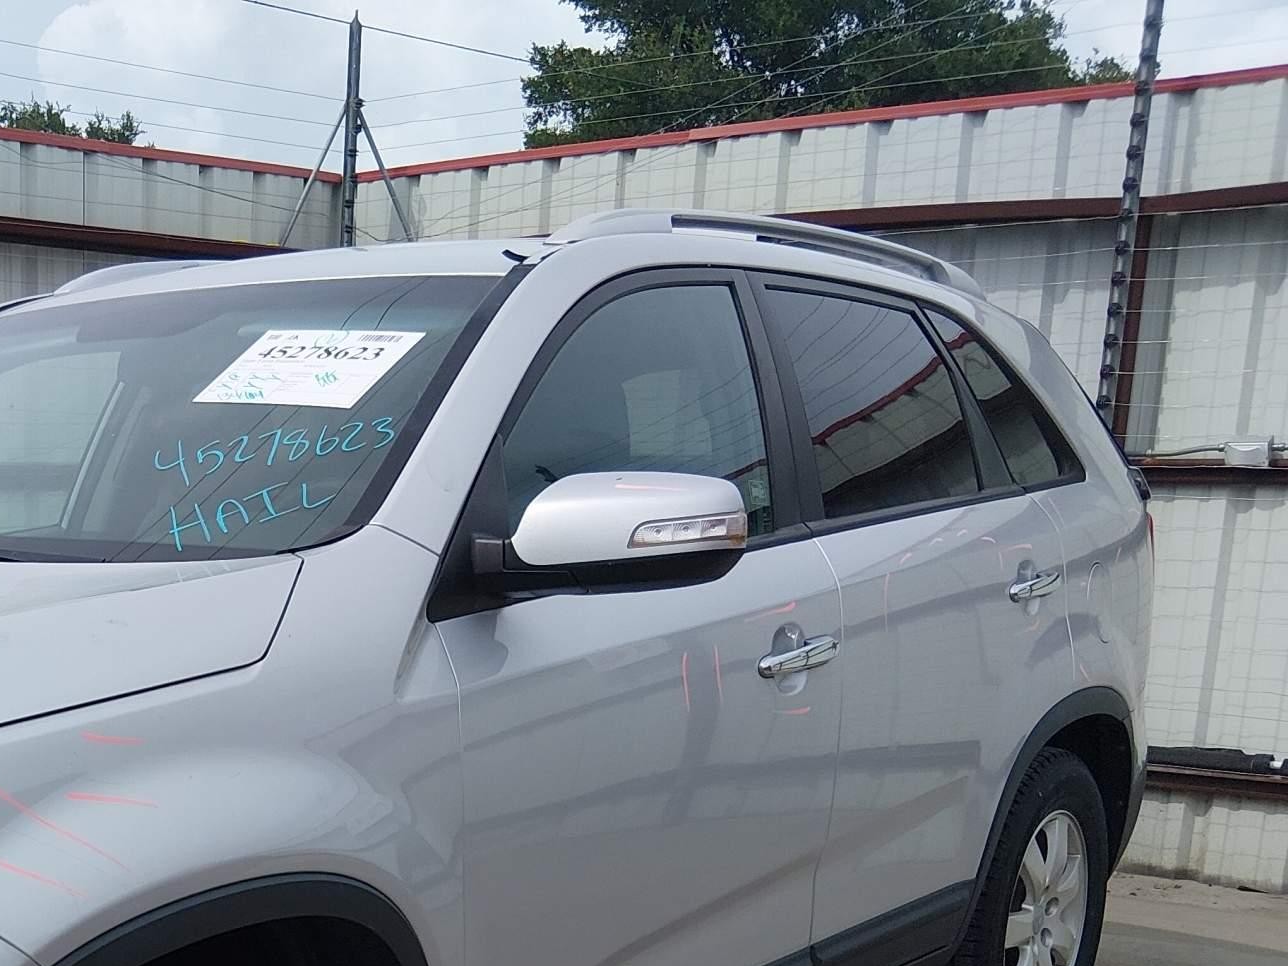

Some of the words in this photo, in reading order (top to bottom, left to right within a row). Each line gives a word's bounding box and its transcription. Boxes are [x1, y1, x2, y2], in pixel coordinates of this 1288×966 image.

[257, 345, 385, 361] 45278623
[154, 416, 395, 487] 45278623
[168, 481, 336, 552] HAIL
